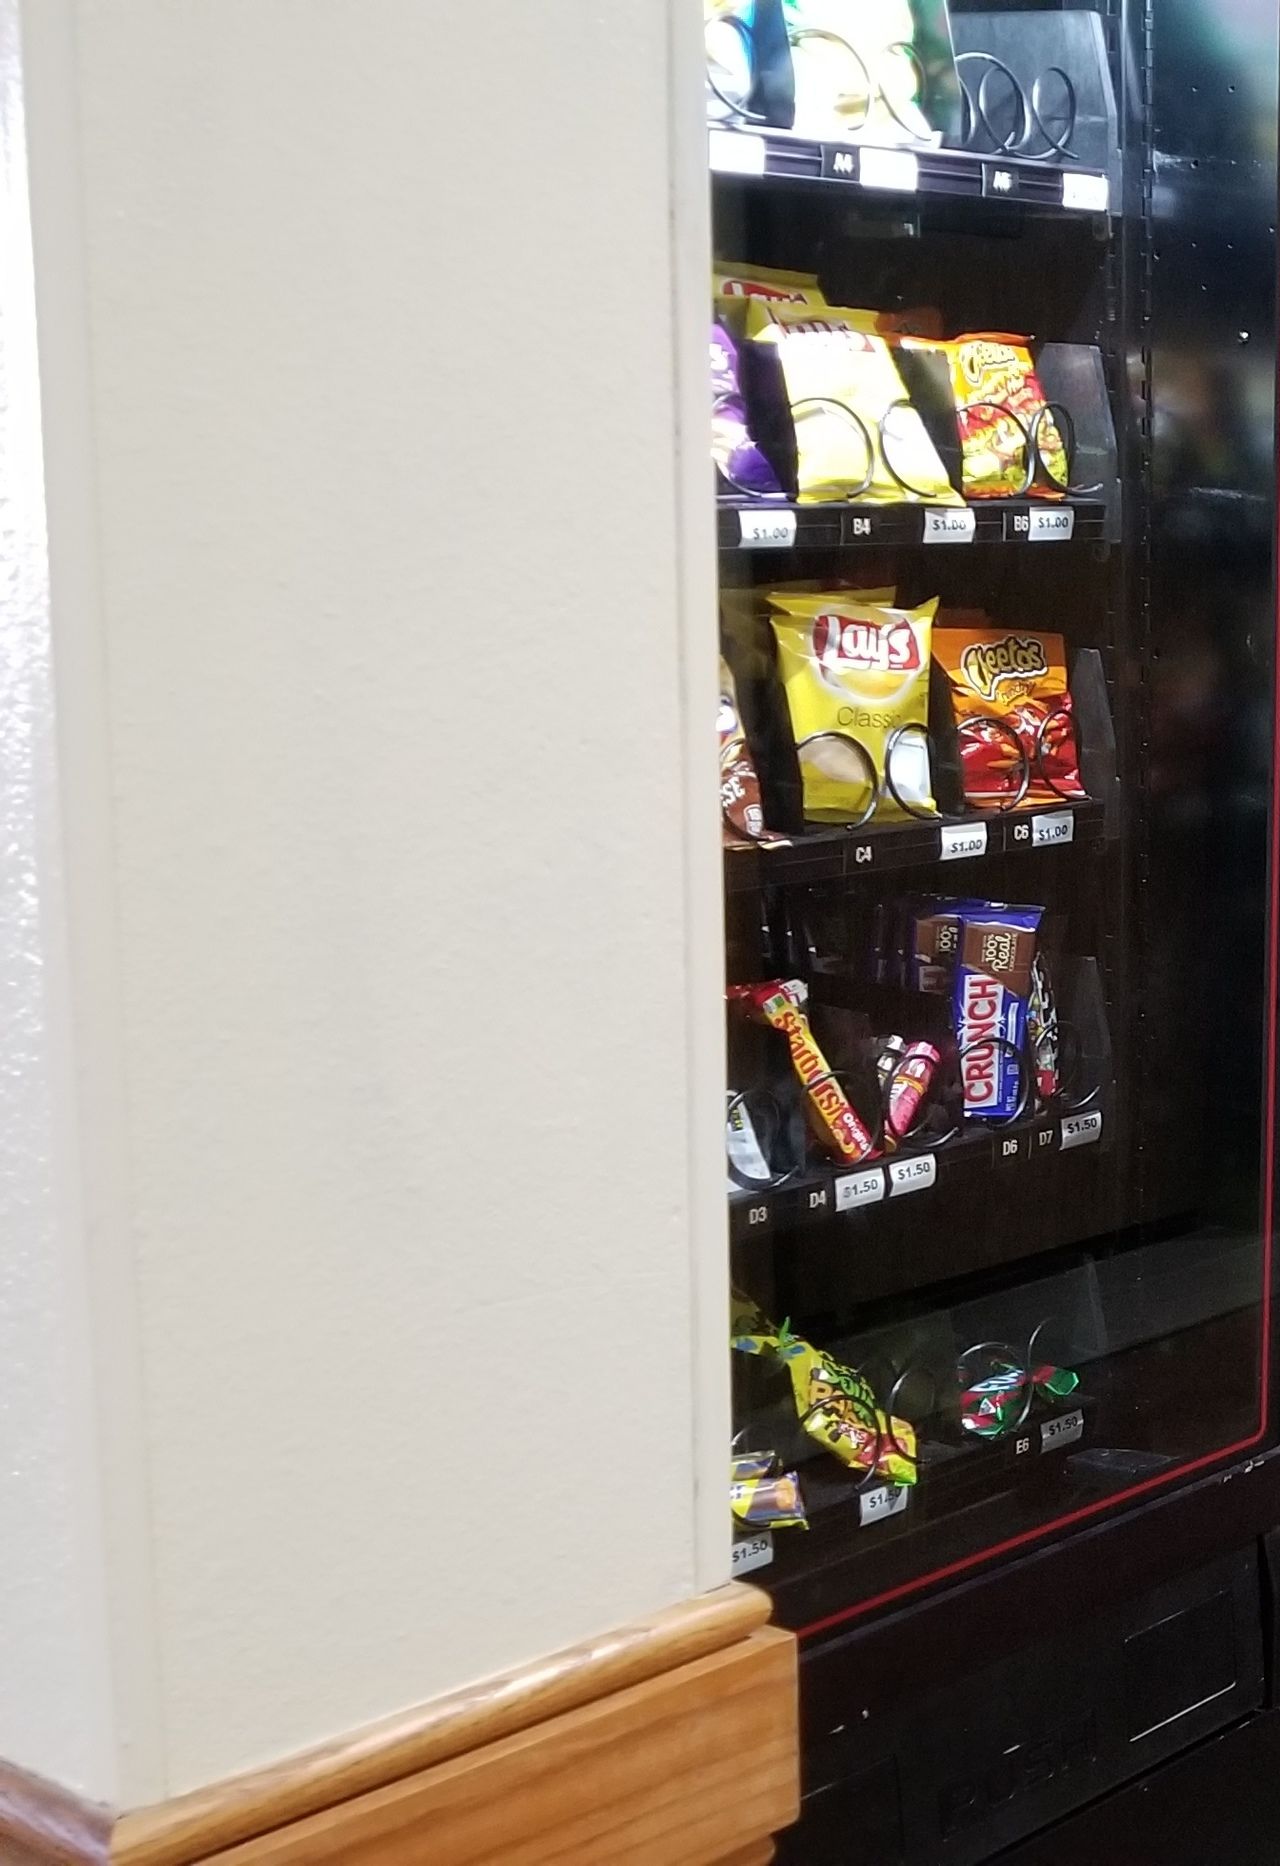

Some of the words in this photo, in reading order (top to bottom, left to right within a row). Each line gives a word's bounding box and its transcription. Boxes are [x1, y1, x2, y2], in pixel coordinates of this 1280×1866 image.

[853, 517, 871, 535] B4
[932, 519, 967, 532] $1.00
[1014, 515, 1029, 531] B6
[1038, 516, 1069, 529] $1.00
[752, 526, 789, 541] $1.00
[824, 615, 914, 669] Lay's
[1014, 825, 1029, 840] C6
[1038, 825, 1068, 841] $1.00
[856, 846, 872, 863] C4
[951, 839, 983, 853] $1.00
[985, 933, 997, 962] 100%
[992, 933, 1012, 973] Real
[964, 977, 997, 1104] CRUNCH
[1066, 1118, 1098, 1134] $1.50
[1039, 1130, 1054, 1147] D7
[1002, 1140, 1018, 1156] D6
[897, 1162, 931, 1180] $1.50
[842, 1179, 879, 1198] $1.50
[809, 1191, 826, 1208] D4
[749, 1207, 767, 1224] D3
[1048, 1416, 1079, 1435] $1.50
[1016, 1438, 1030, 1455] E6
[868, 1486, 901, 1508] $1.50
[732, 1540, 768, 1562] $1.50
